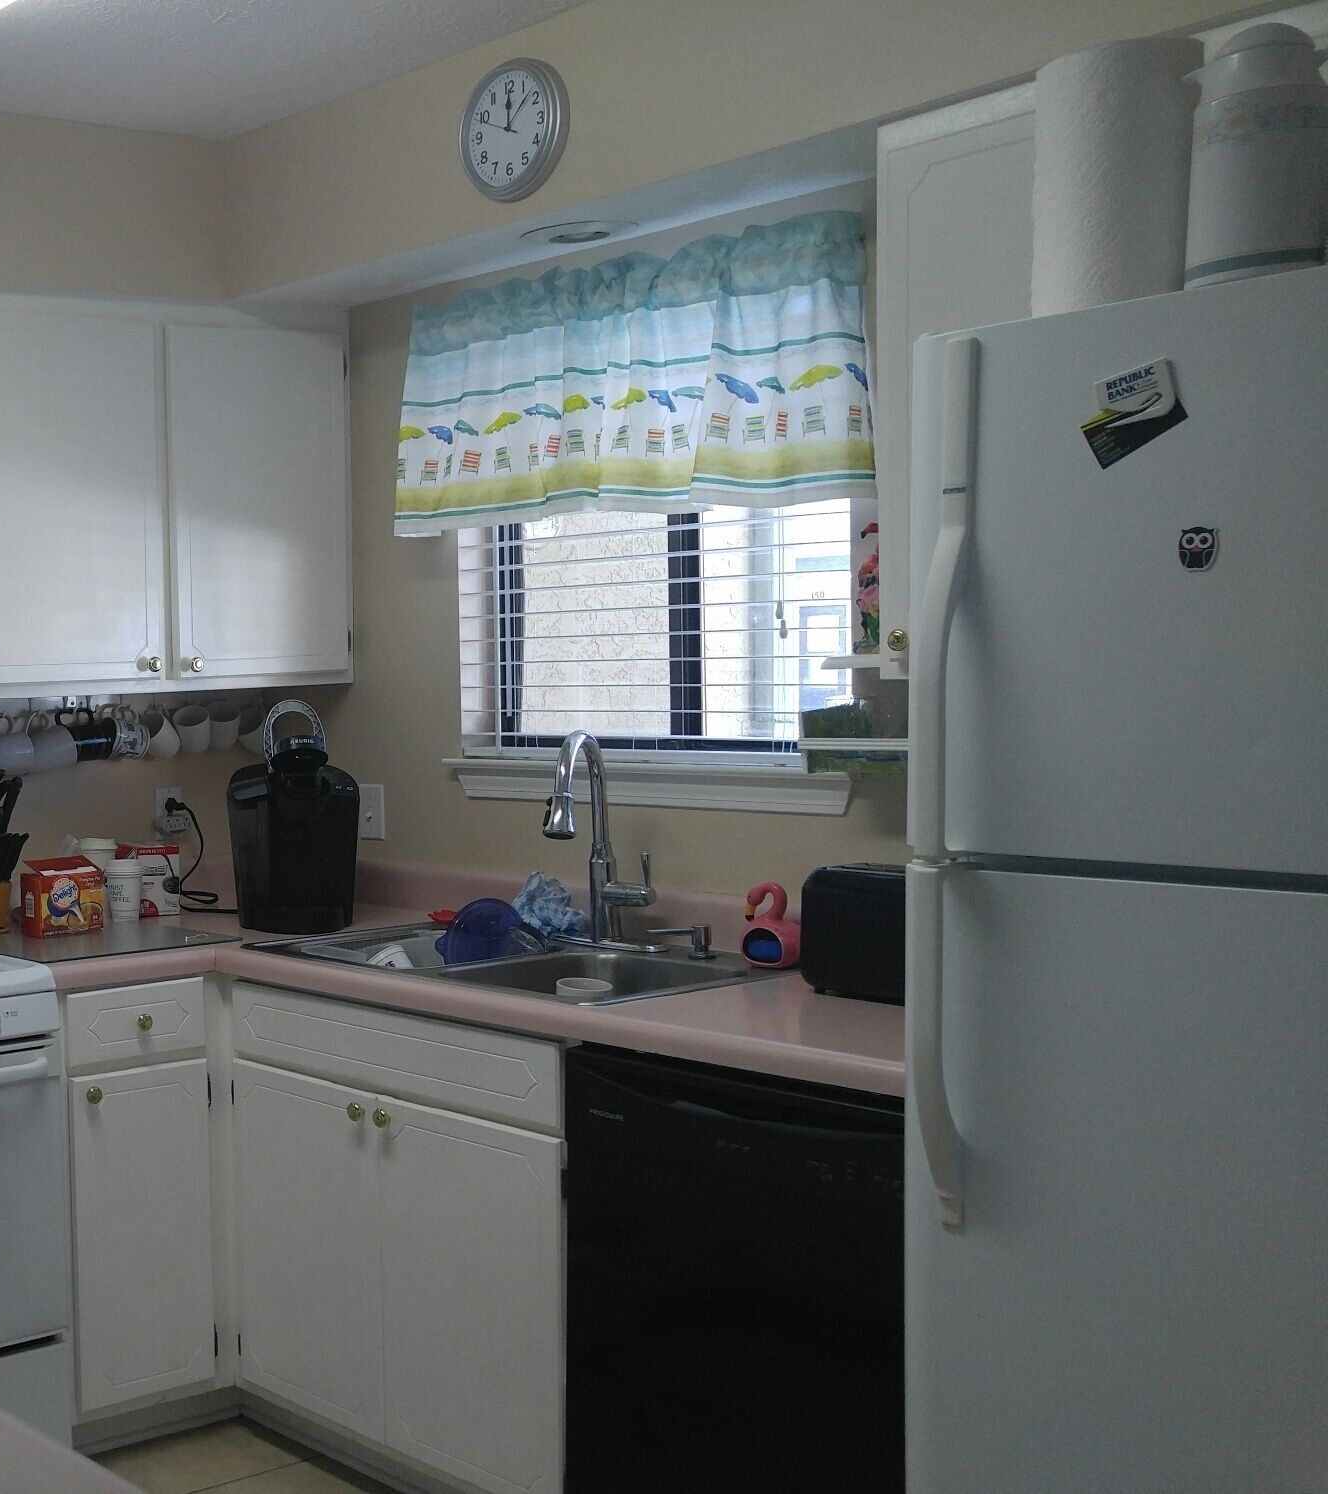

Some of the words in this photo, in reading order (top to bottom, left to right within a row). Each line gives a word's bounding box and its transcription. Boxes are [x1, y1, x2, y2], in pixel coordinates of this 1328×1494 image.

[504, 80, 515, 95] 12
[532, 91, 540, 105] 2
[479, 110, 490, 125] 10
[536, 111, 545, 125] 3
[475, 131, 483, 145] 9
[532, 132, 541, 147] 4
[480, 150, 488, 165] 8
[521, 151, 529, 166] 5
[491, 161, 499, 176] 7
[505, 162, 514, 176] 6
[1106, 366, 1156, 391] REPUBLIC
[1107, 384, 1137, 401] BANK
[53, 884, 77, 902] Delight
